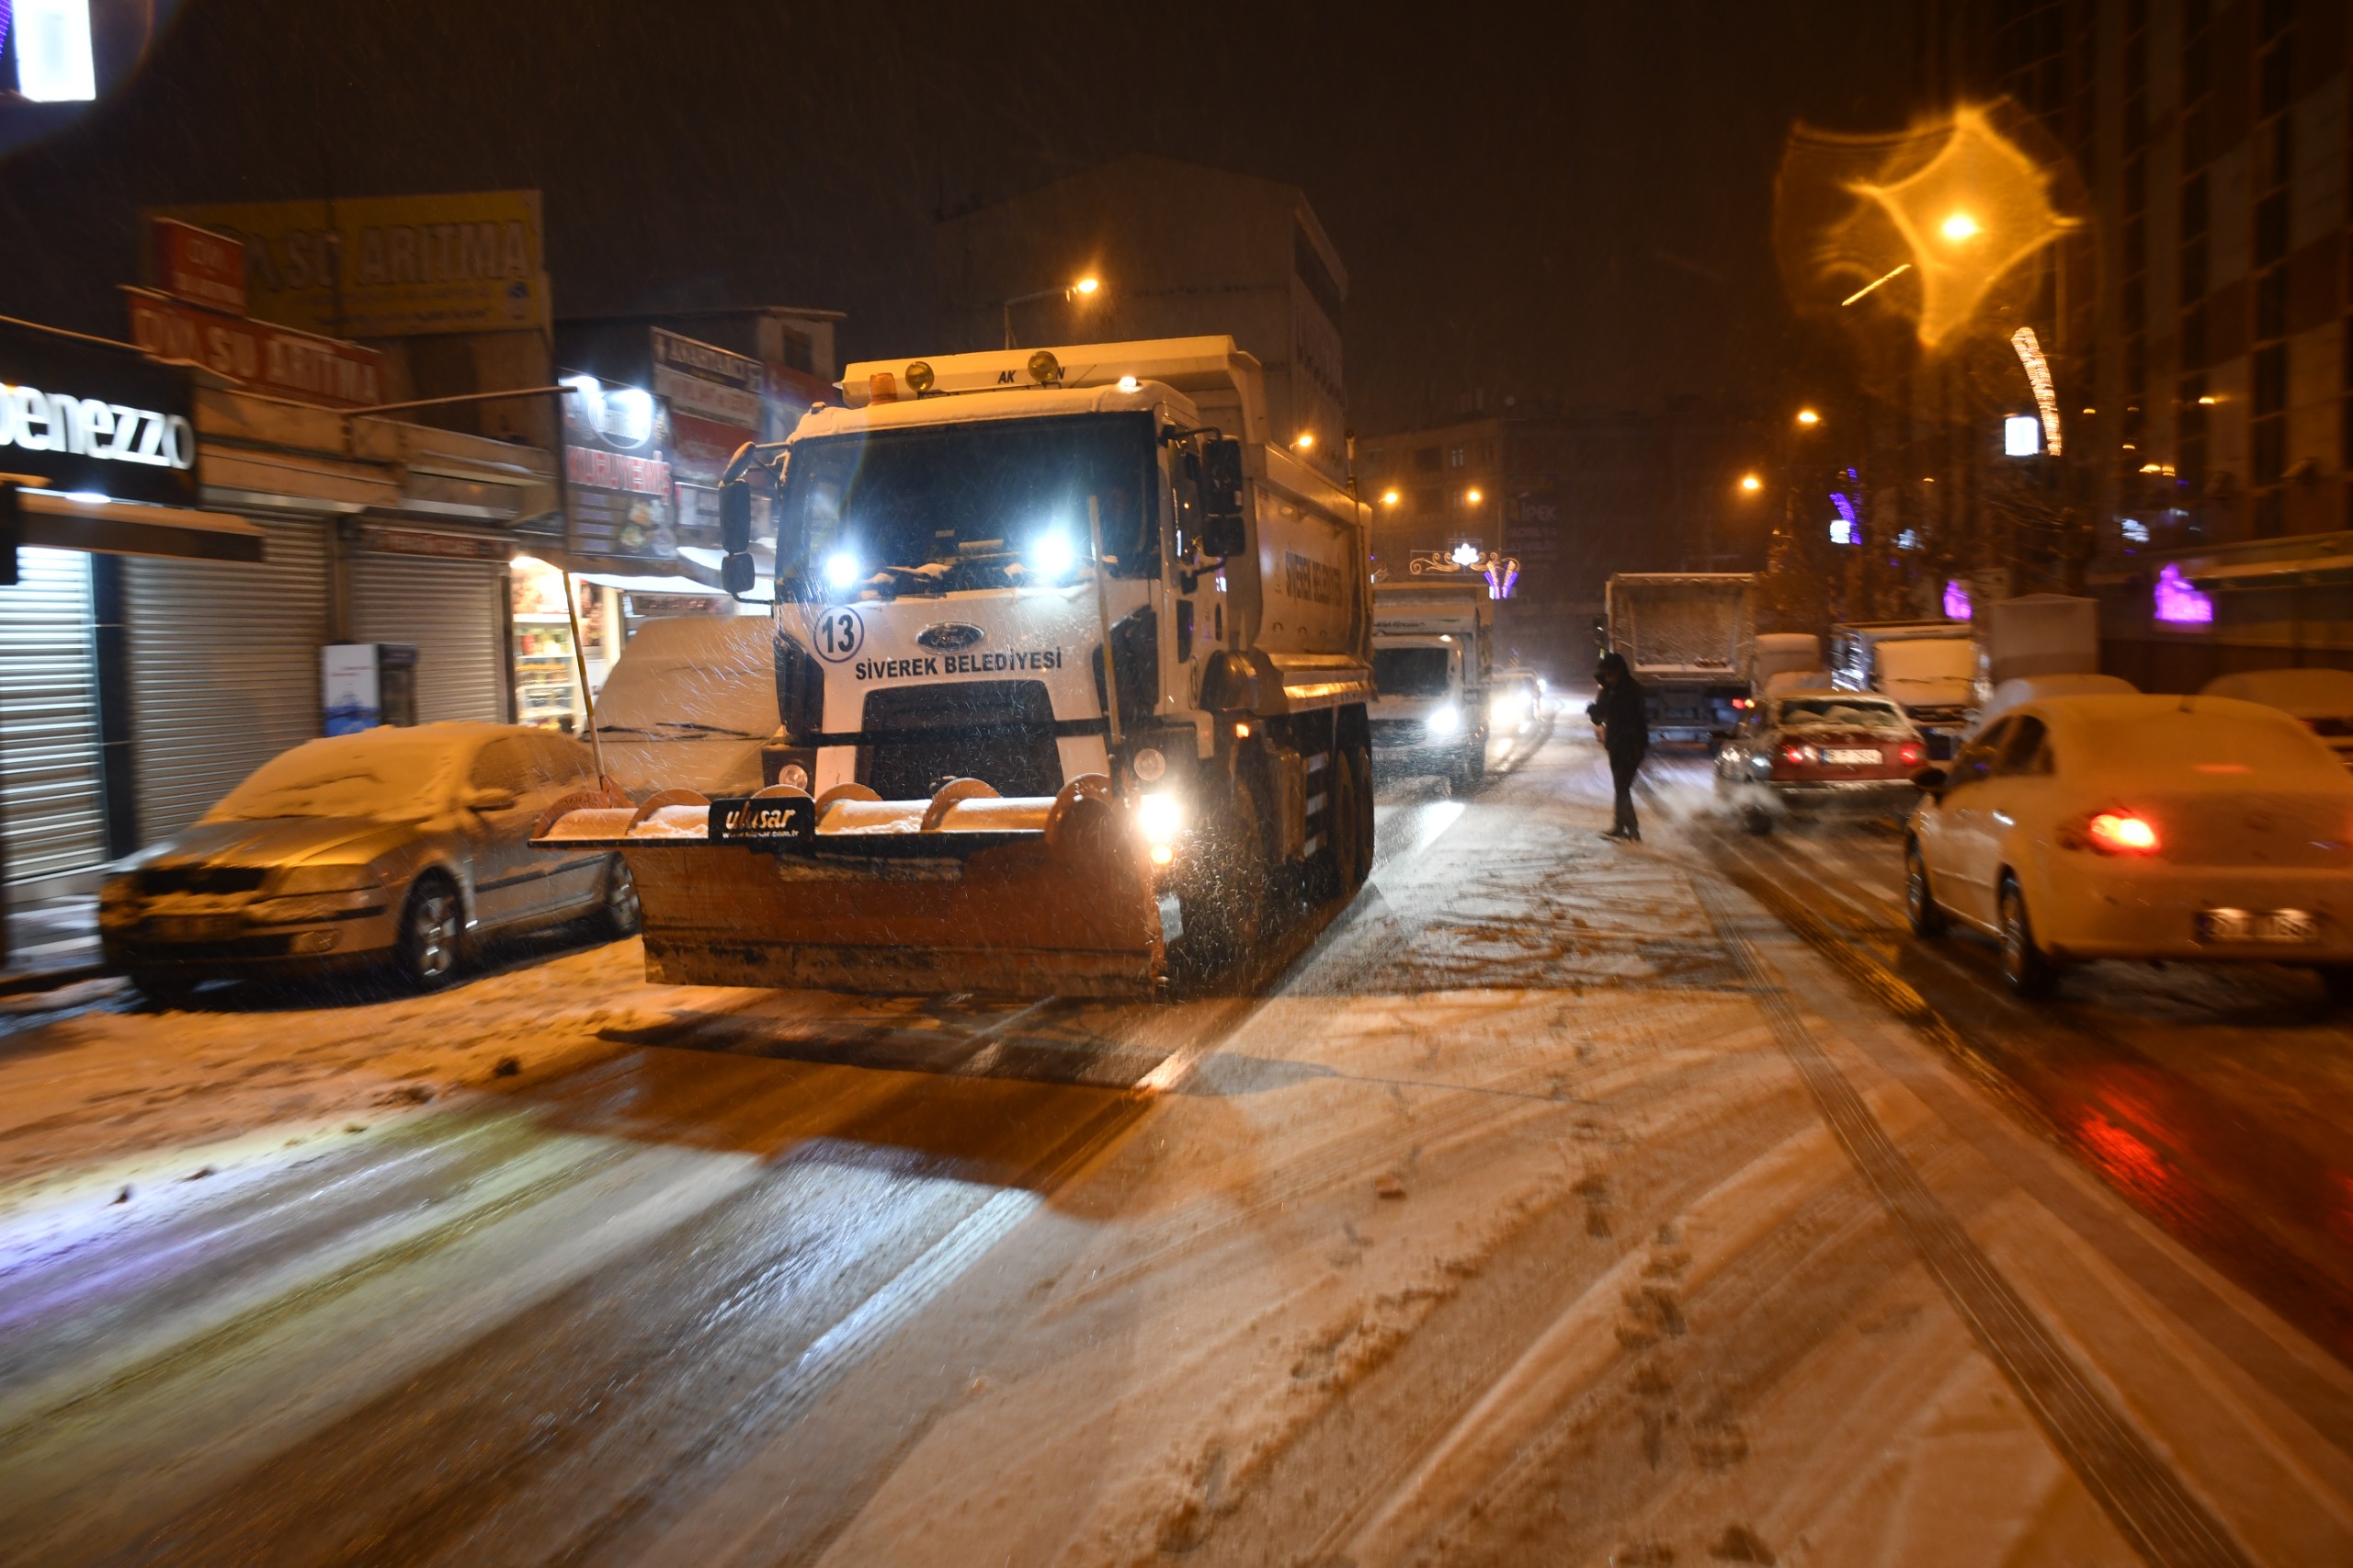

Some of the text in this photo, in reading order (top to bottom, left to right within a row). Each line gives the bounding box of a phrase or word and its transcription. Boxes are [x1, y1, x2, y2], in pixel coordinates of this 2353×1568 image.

[822, 614, 855, 653] 13
[855, 646, 1063, 681] SİVEREK BELEDİYESİ
